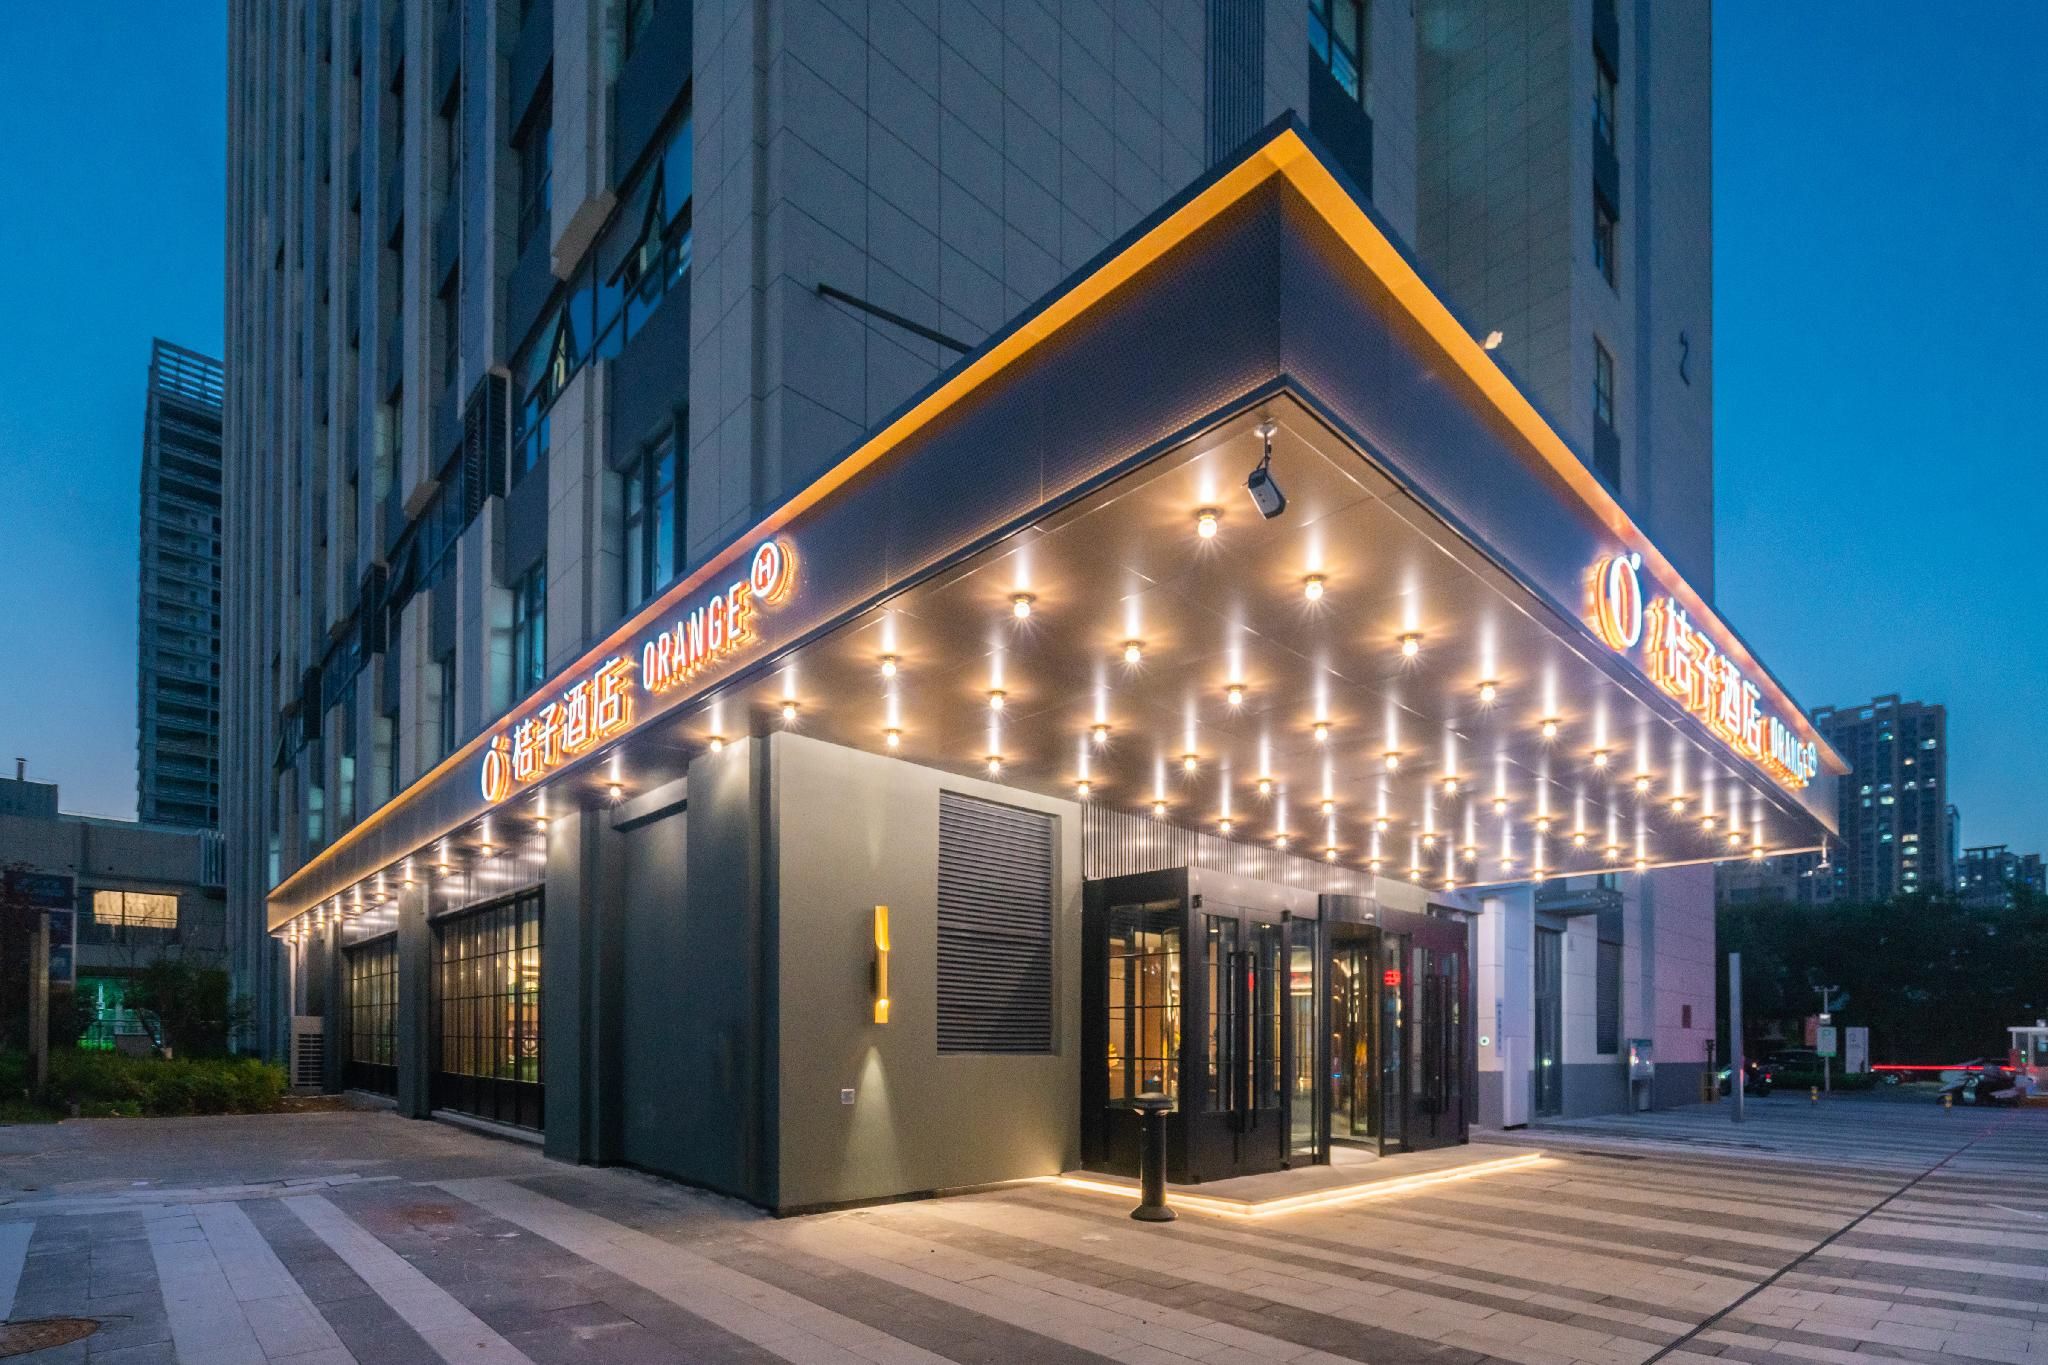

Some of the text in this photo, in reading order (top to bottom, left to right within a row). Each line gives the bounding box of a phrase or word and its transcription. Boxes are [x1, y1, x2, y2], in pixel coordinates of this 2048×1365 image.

[512, 656, 622, 780] 桔子酒店
[643, 581, 742, 690] ORANGE
[1665, 597, 1761, 753] 桔子酒店
